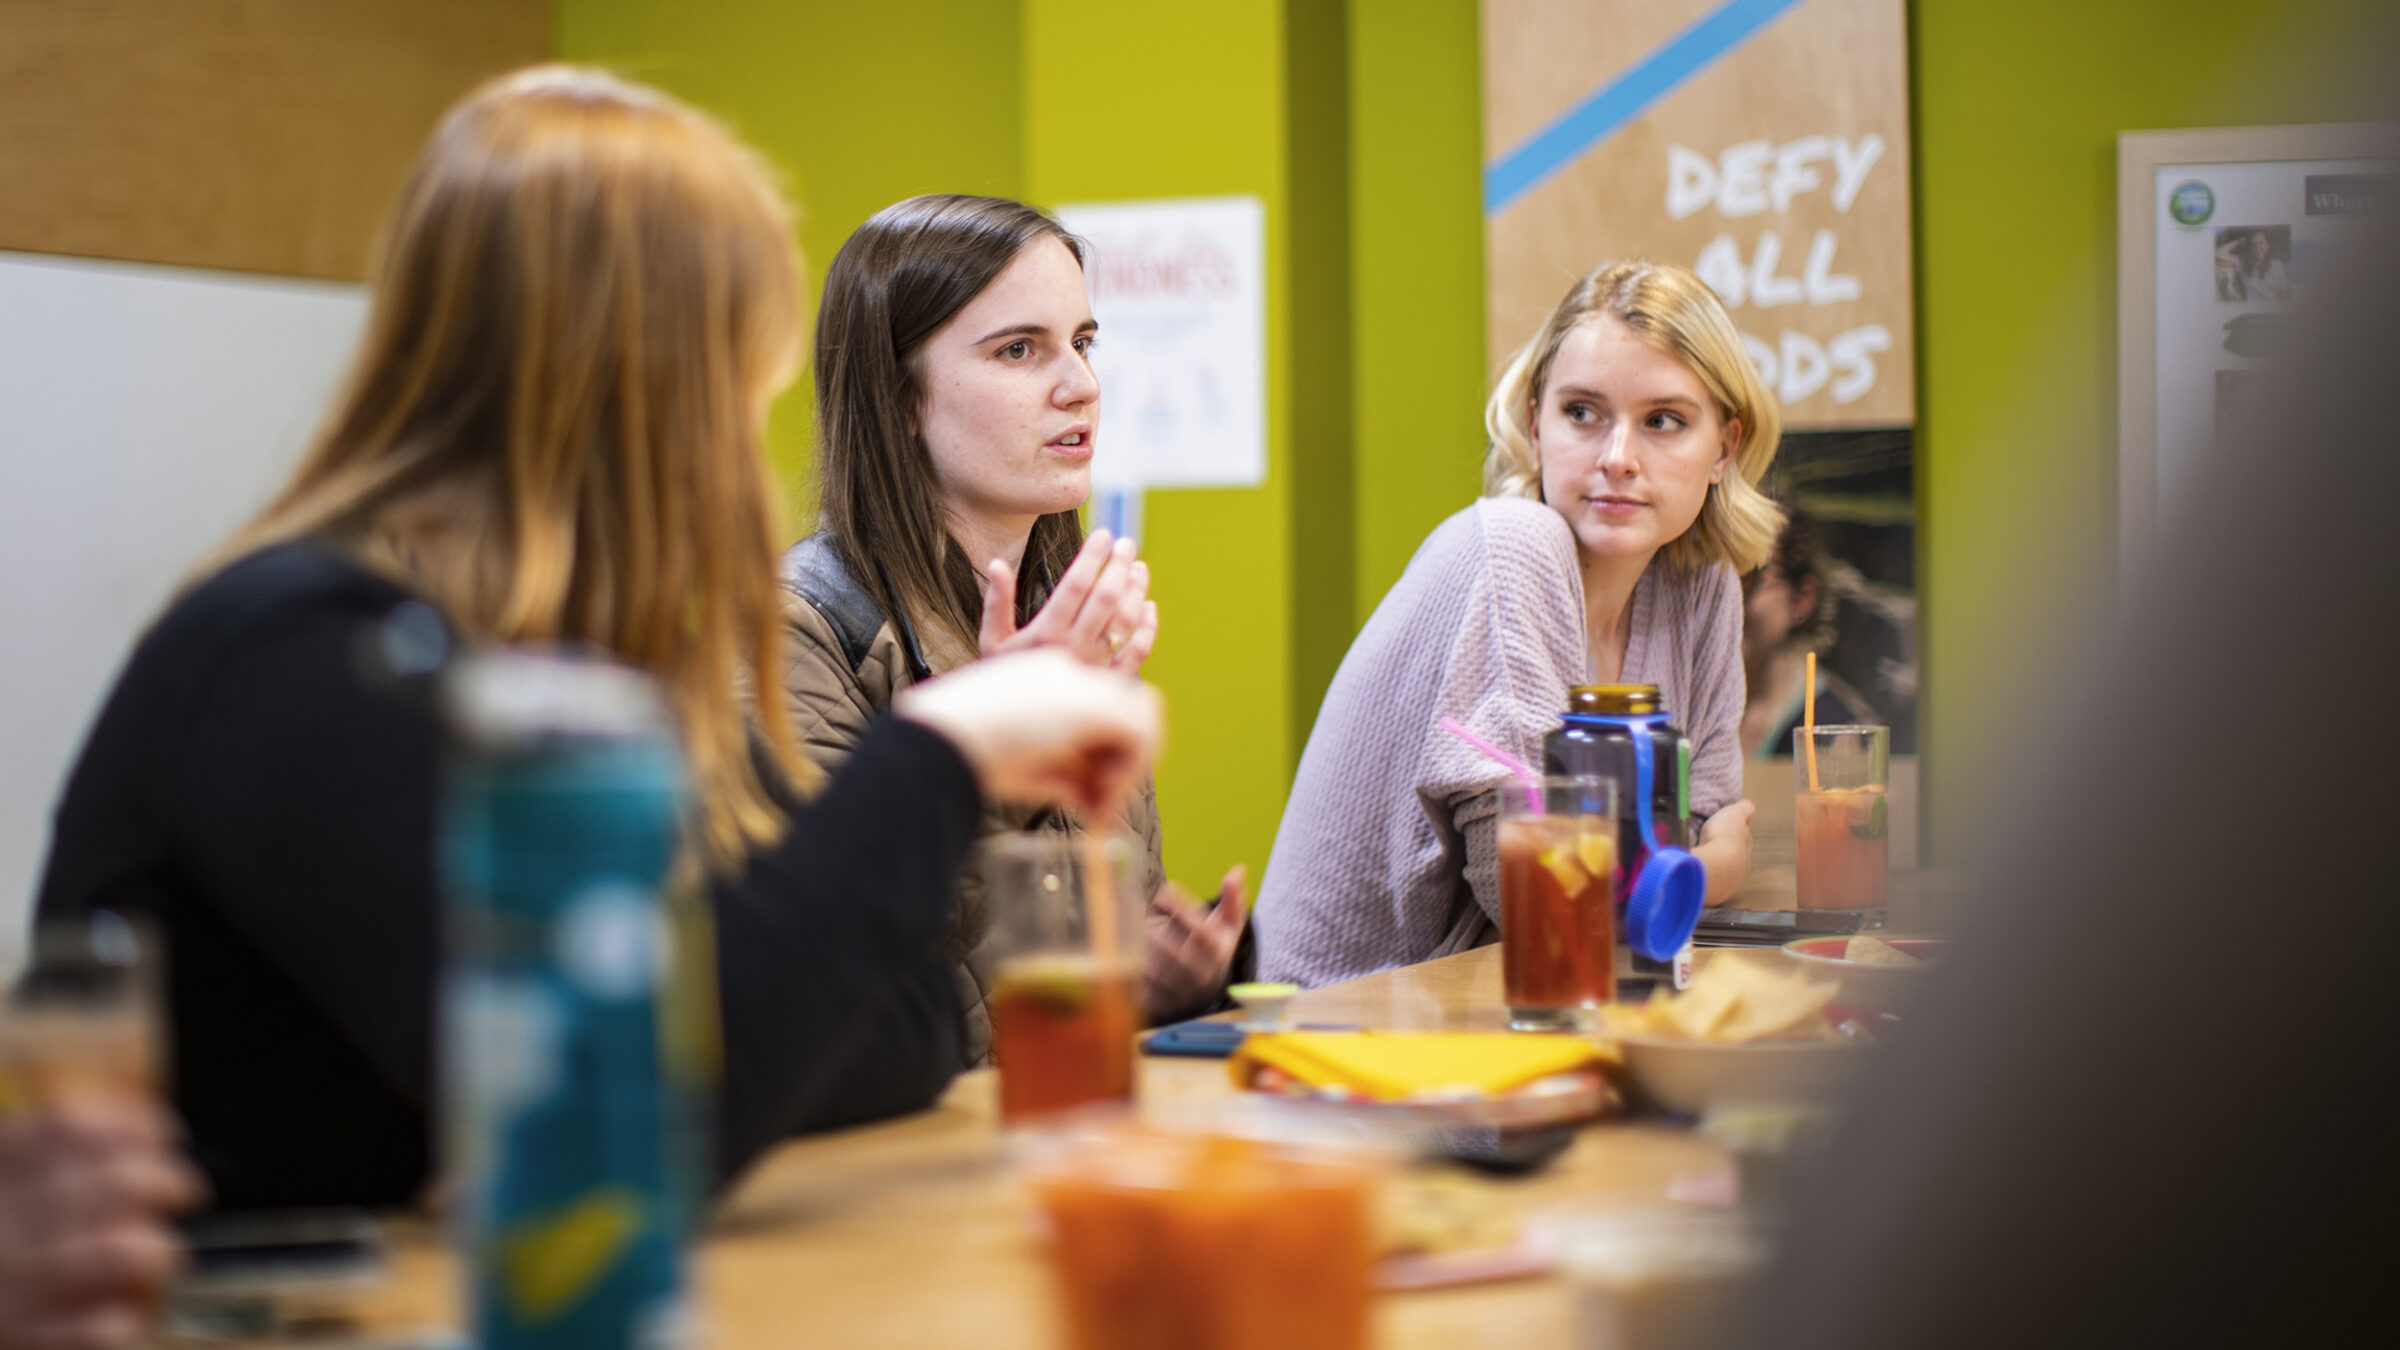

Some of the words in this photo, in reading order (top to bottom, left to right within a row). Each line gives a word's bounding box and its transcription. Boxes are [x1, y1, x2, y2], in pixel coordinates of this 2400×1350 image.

[1666, 135, 1884, 219] DEFY
[1696, 230, 1861, 307] ALL
[1738, 326, 1891, 403] DDS
